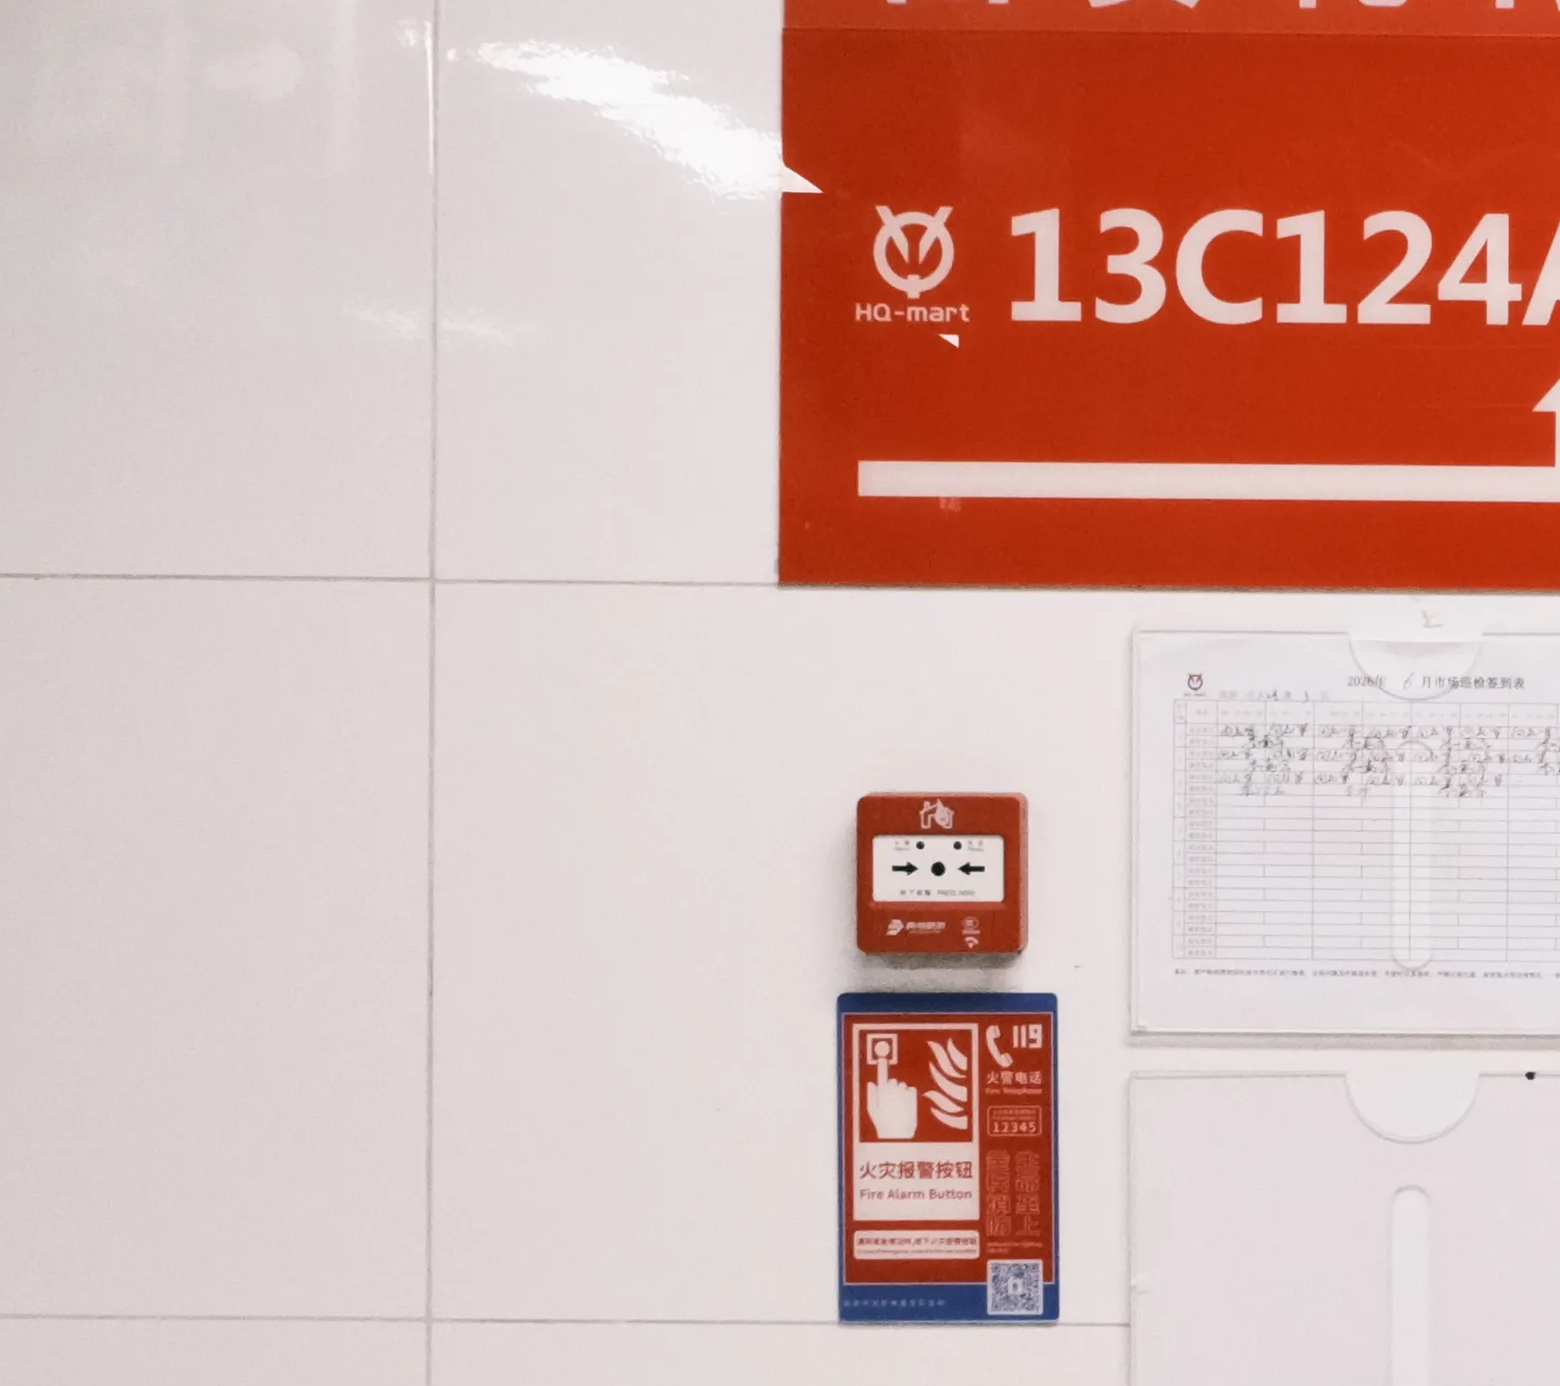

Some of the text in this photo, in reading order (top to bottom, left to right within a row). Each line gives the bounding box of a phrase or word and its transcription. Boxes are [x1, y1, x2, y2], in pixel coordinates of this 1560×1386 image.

[854, 302, 970, 323] HQ-mart
[1012, 1024, 1043, 1049] 119
[987, 1071, 1042, 1085] 火警电话
[992, 1121, 1037, 1133] 12345
[859, 1160, 974, 1180] 火灾报警按钮
[859, 1189, 973, 1200] Fire Alarm Button
